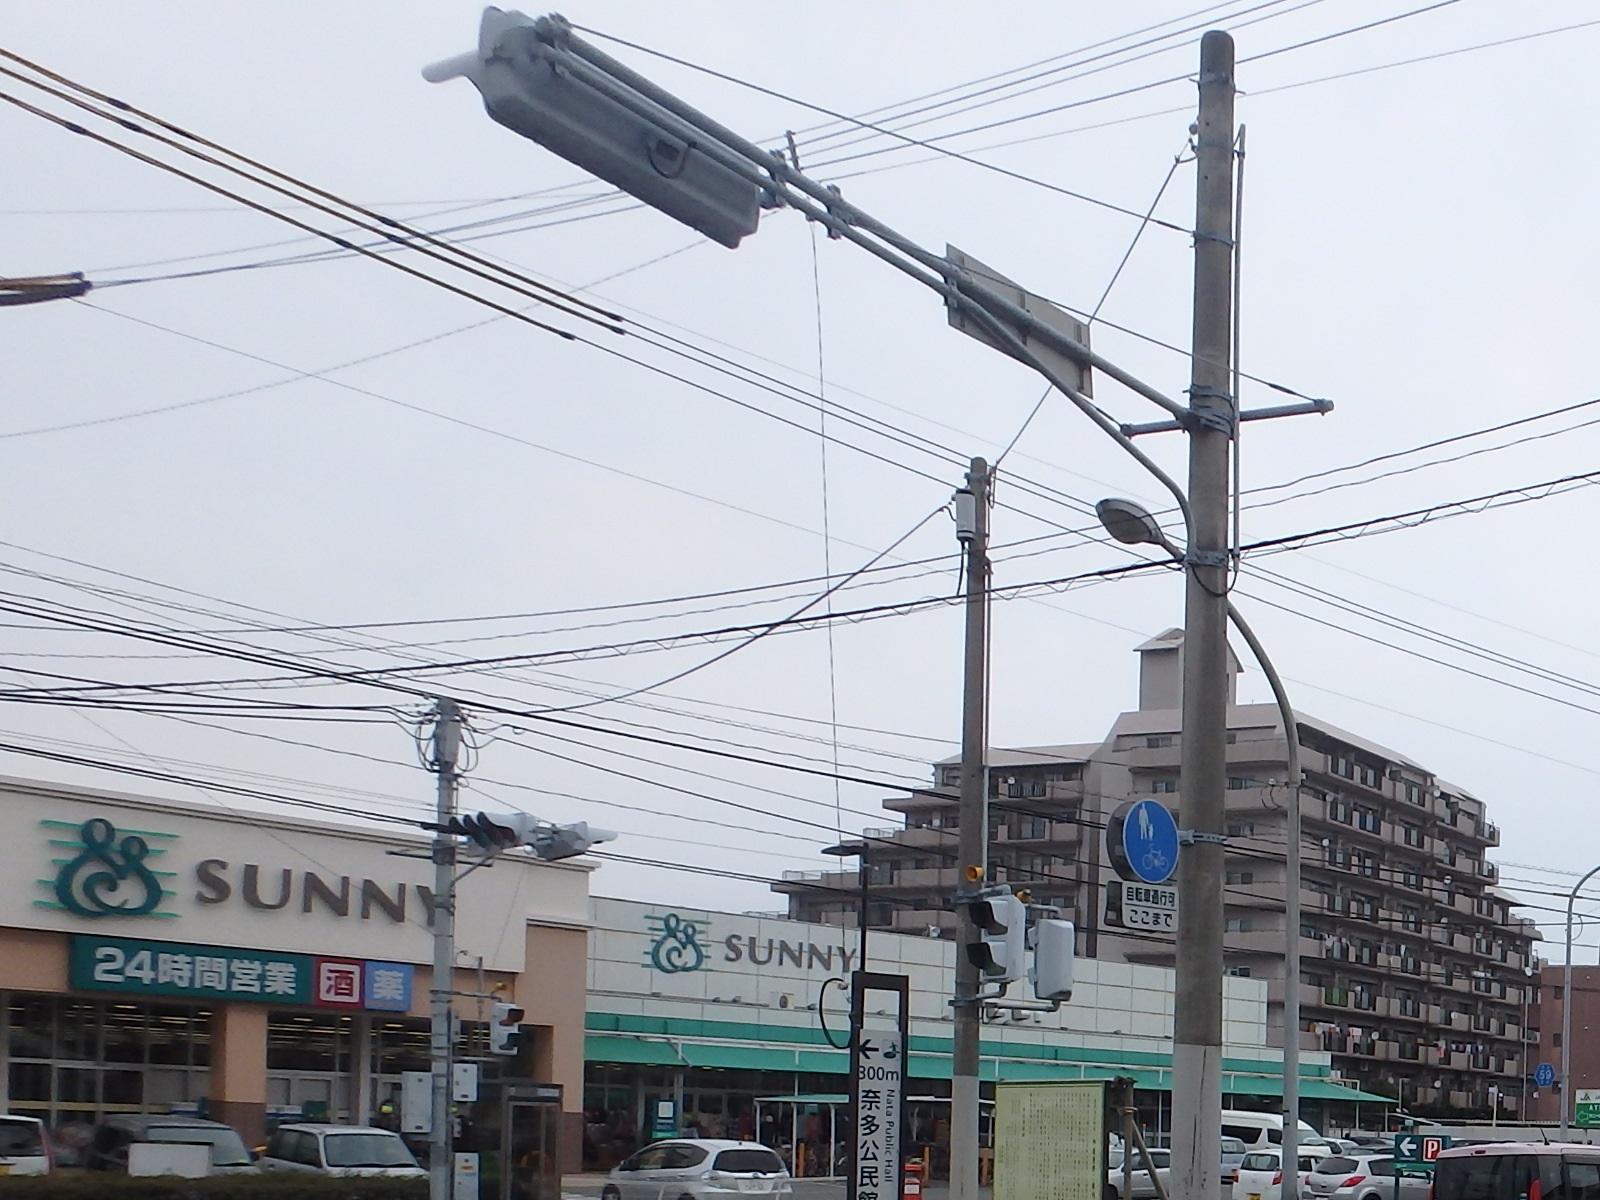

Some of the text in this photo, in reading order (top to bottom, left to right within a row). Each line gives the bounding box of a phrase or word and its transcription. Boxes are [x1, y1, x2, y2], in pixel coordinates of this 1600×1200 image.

[1129, 909, 1173, 928] ここまで
[724, 933, 858, 974] SUNNY
[93, 945, 298, 996] 24時間営業
[325, 968, 355, 999] 酒
[373, 968, 405, 1001] 薬
[858, 1065, 900, 1082] 300m
[1538, 1069, 1553, 1081] 59
[883, 1088, 896, 1183] Nata Public Hall
[1426, 1139, 1439, 1160] P
